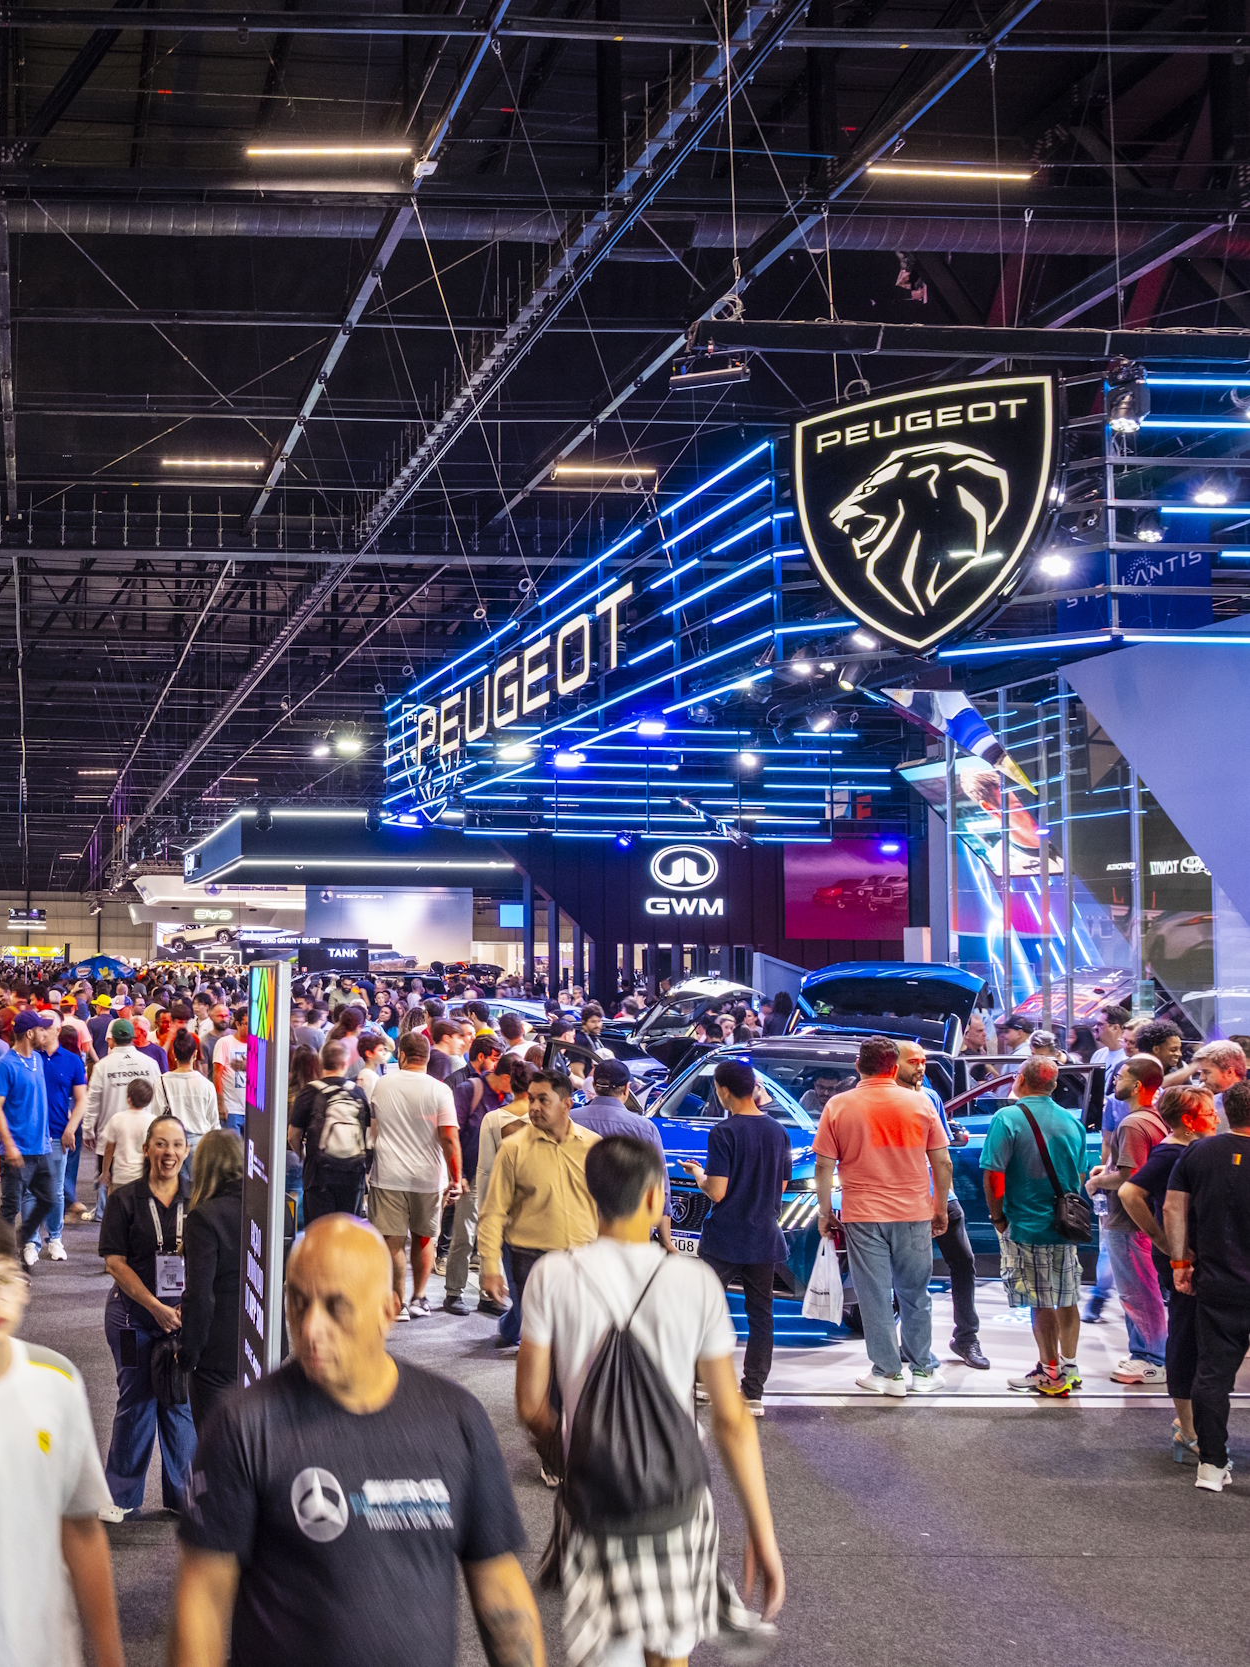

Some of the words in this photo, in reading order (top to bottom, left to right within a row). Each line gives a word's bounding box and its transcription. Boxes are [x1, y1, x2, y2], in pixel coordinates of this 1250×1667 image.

[817, 398, 1028, 454] PEUGEOT
[1066, 551, 1202, 609] SLANTIS
[417, 581, 633, 765] PEUGEOT
[194, 909, 232, 920] BYD
[645, 897, 724, 916] GWM
[327, 948, 358, 958] TANK
[107, 1070, 150, 1079] PETRONAS
